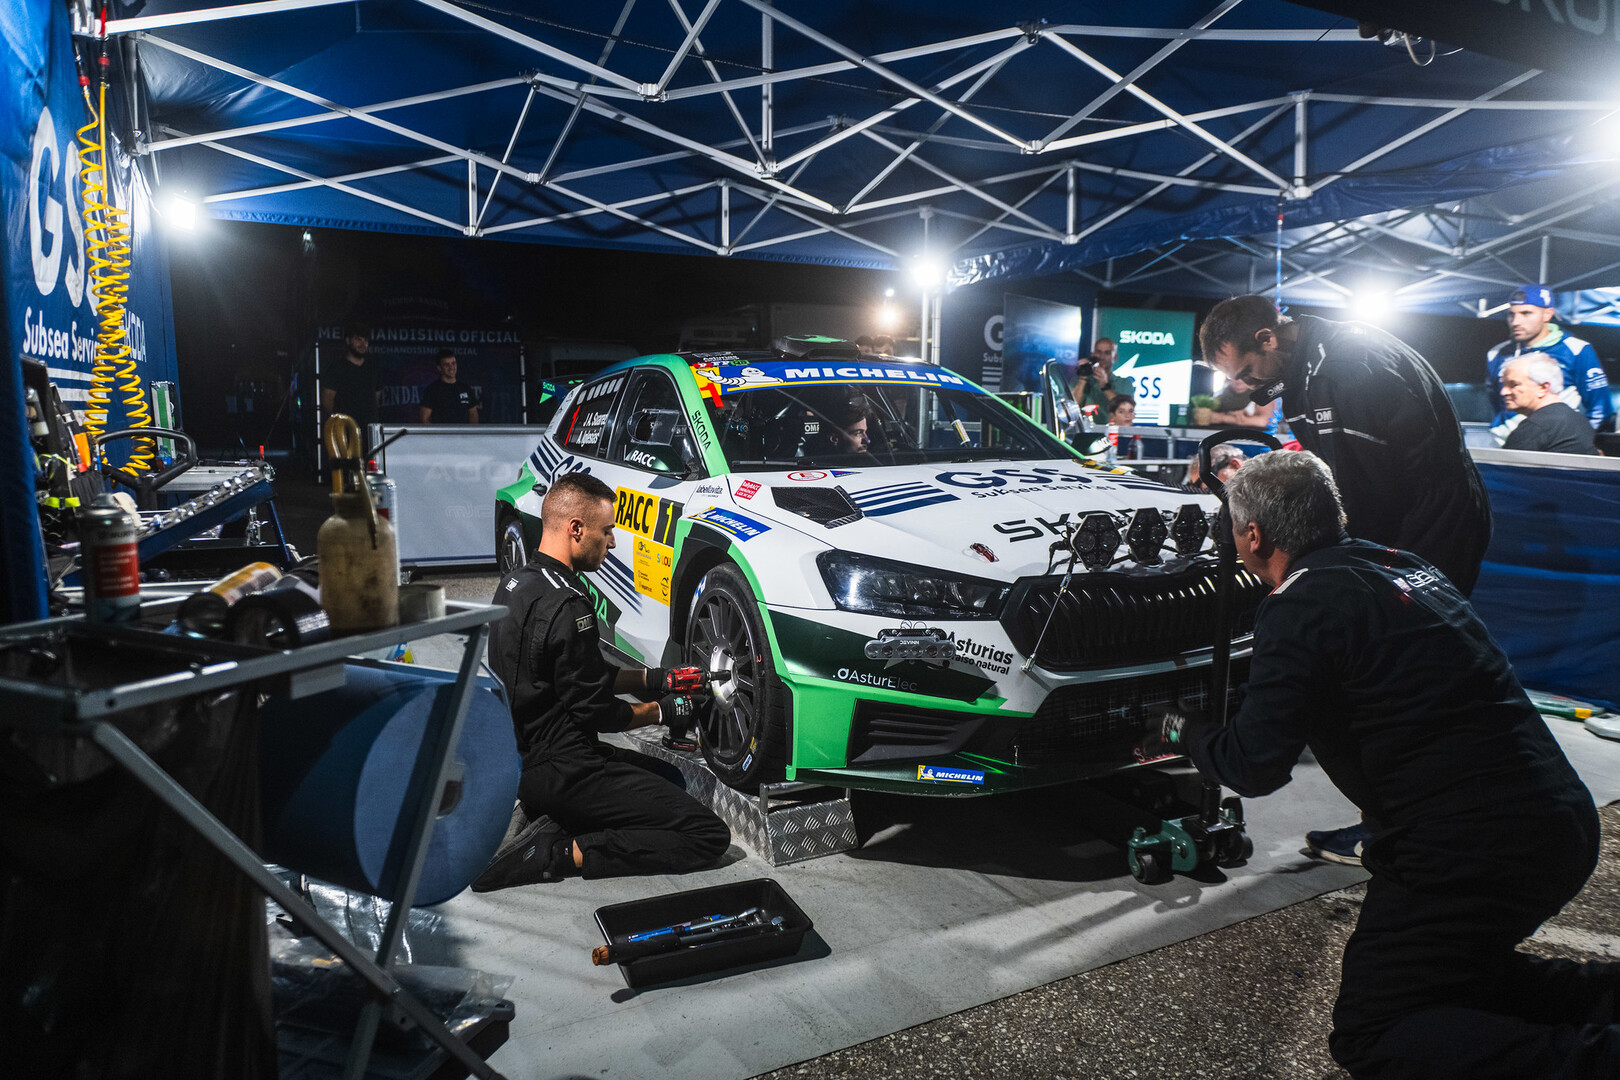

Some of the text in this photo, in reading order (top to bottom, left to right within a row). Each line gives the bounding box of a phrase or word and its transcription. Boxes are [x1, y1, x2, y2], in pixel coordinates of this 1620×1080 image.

[23, 306, 69, 360] Subsea
[458, 328, 521, 344] OFICIAL
[1119, 330, 1175, 346] SKODA
[784, 367, 964, 386] MICHELIN
[700, 382, 725, 408] 1
[691, 409, 712, 452] SKODA
[630, 449, 656, 468] RACC
[616, 490, 654, 534] RACC
[661, 502, 674, 544] 1
[711, 511, 760, 537] MICHELIN
[946, 631, 1014, 665] Asturias
[975, 659, 1010, 676] natural
[935, 771, 983, 781] MICHELIN
